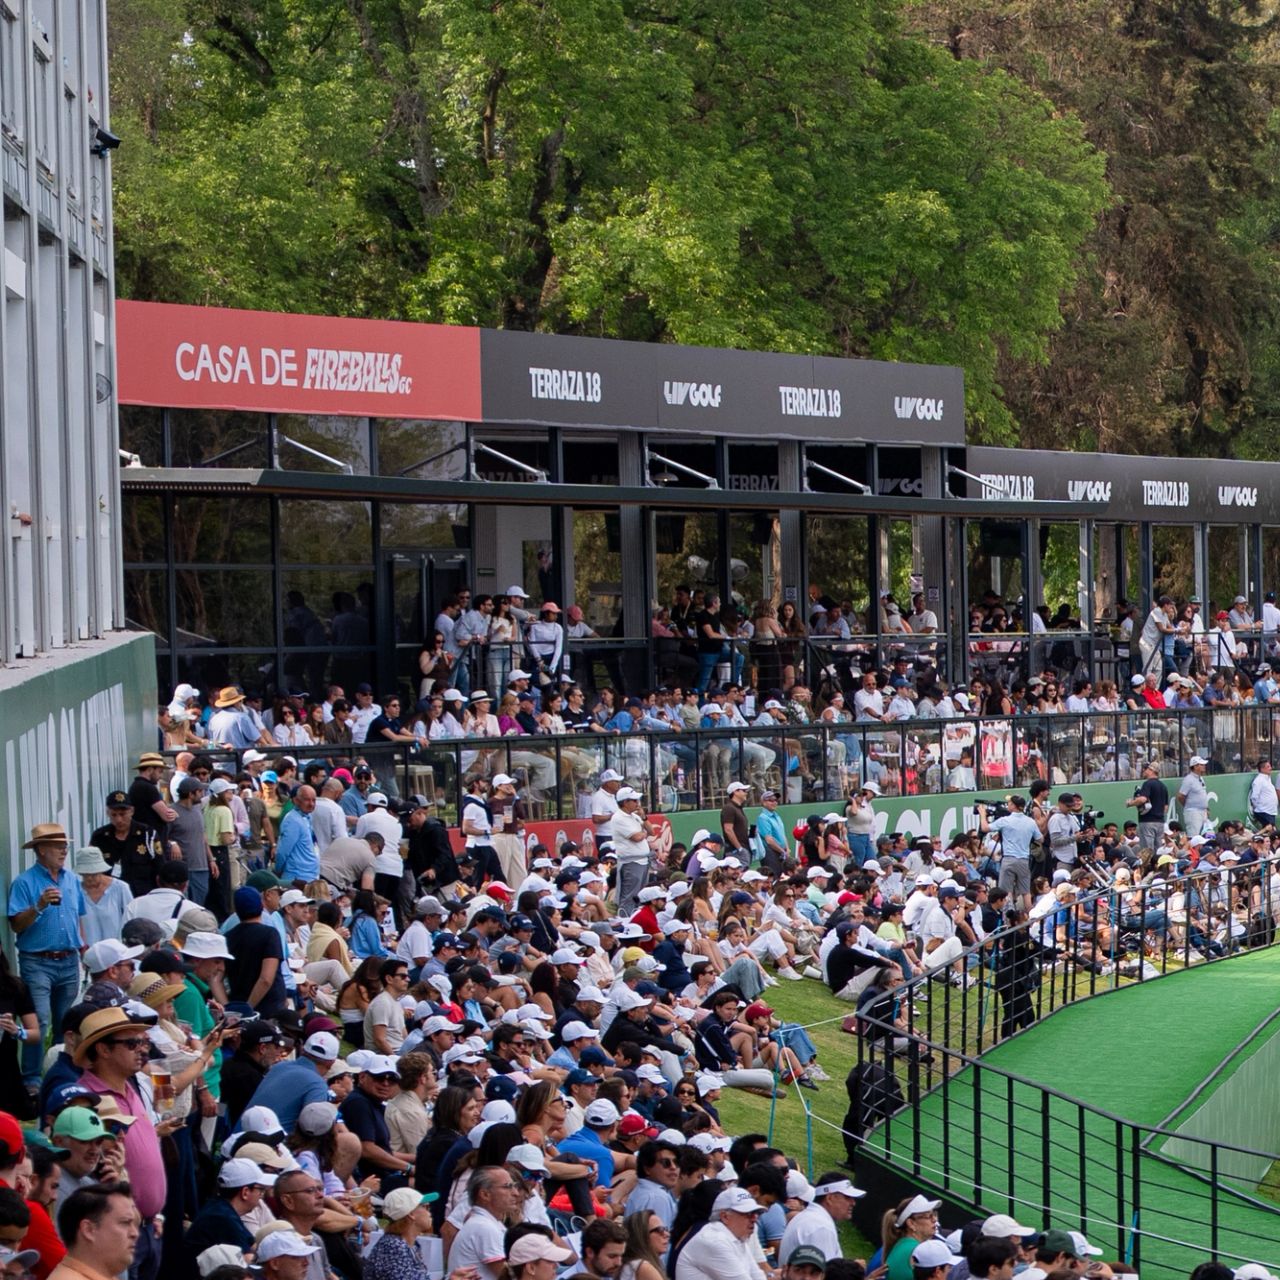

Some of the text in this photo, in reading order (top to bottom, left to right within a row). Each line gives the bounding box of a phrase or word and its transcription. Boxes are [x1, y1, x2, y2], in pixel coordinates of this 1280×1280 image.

[175, 342, 255, 384] CASA
[261, 348, 298, 387] DE
[302, 348, 402, 394] FIREBALLS
[529, 367, 601, 403] TERRAZA 18
[689, 382, 721, 408] GOLF
[779, 386, 841, 418] TERRAZA 18
[915, 397, 943, 420] GOLF
[980, 474, 1034, 500] TERRAZA 18
[1087, 480, 1111, 502] GOLF
[1142, 480, 1189, 507] TERRAZA 18
[1235, 486, 1257, 507] GOLF
